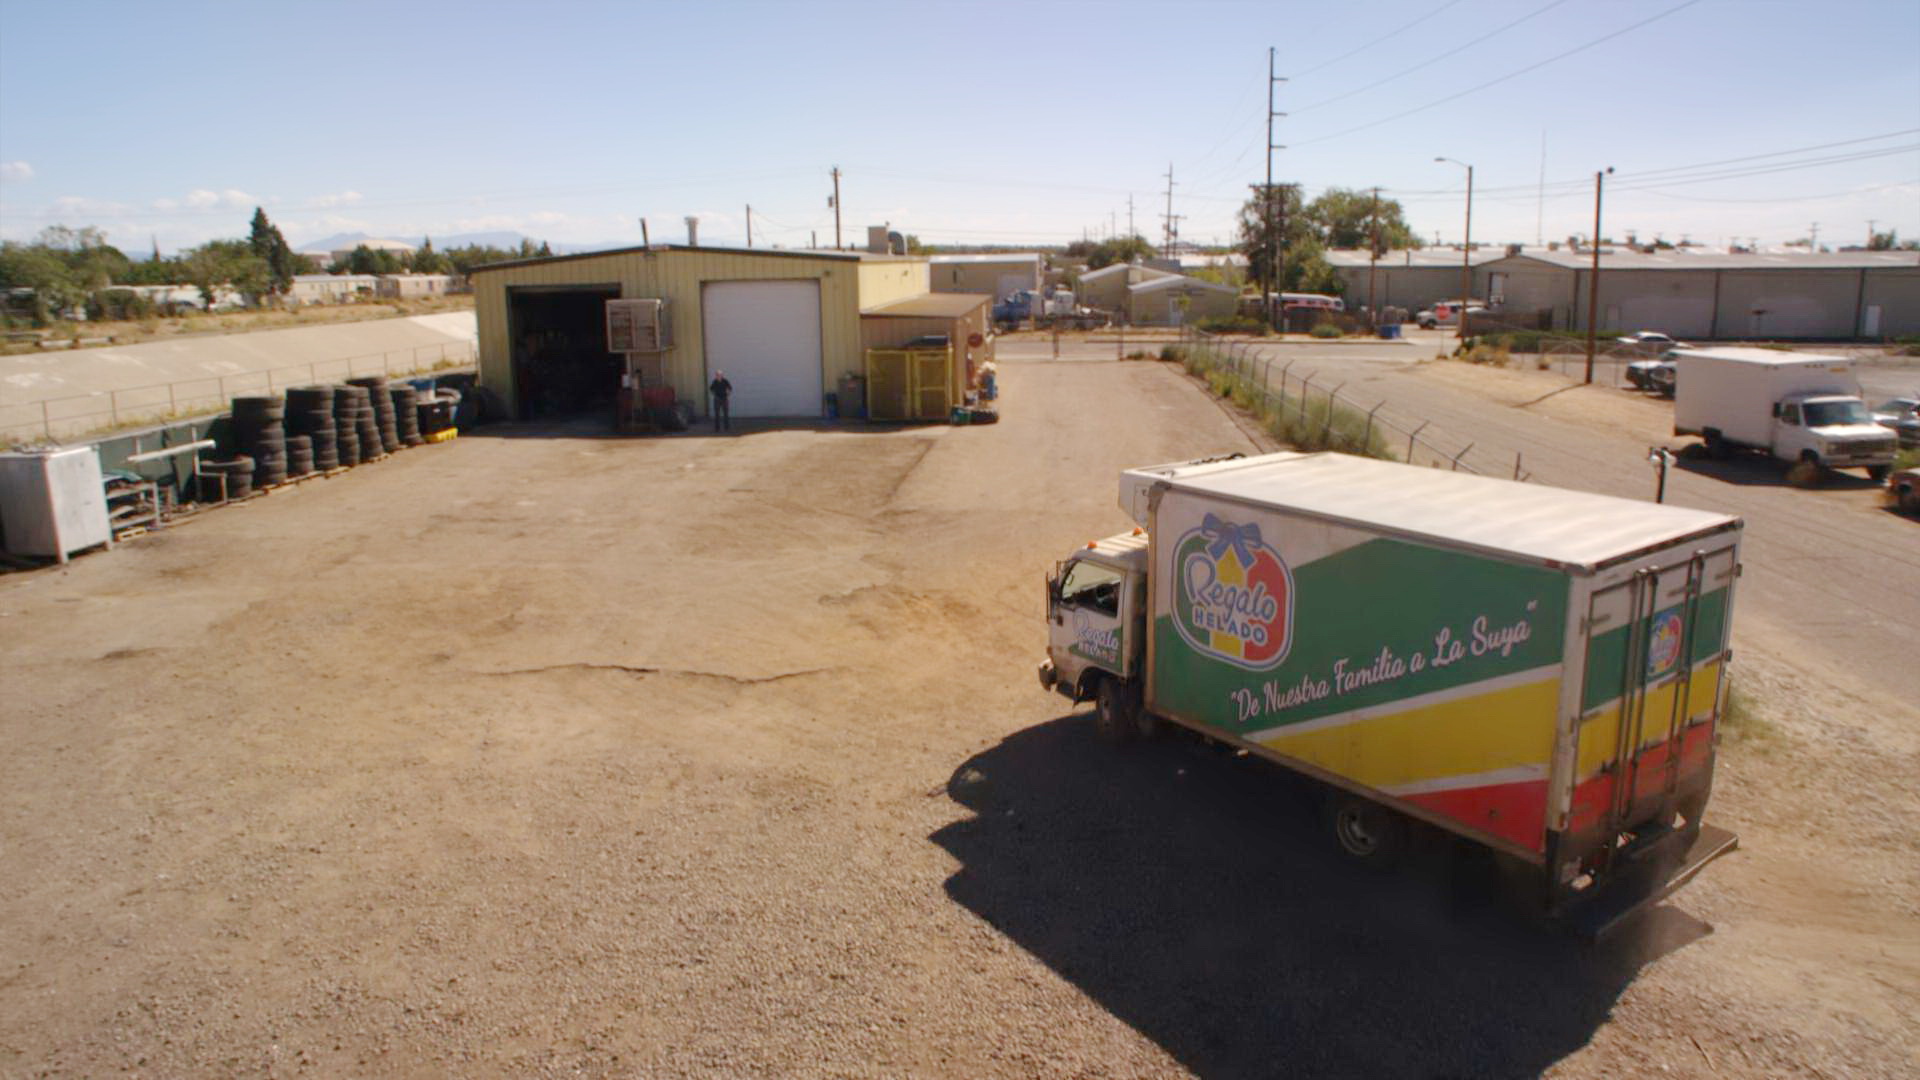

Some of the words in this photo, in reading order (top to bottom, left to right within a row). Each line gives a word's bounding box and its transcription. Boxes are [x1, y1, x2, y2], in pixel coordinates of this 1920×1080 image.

[1187, 554, 1276, 623] Regalo
[1194, 607, 1266, 643] HELADO
[1263, 674, 1331, 714] Nuestra
[1334, 646, 1407, 695] Familia
[1410, 652, 1426, 673] a
[1431, 627, 1466, 667] La
